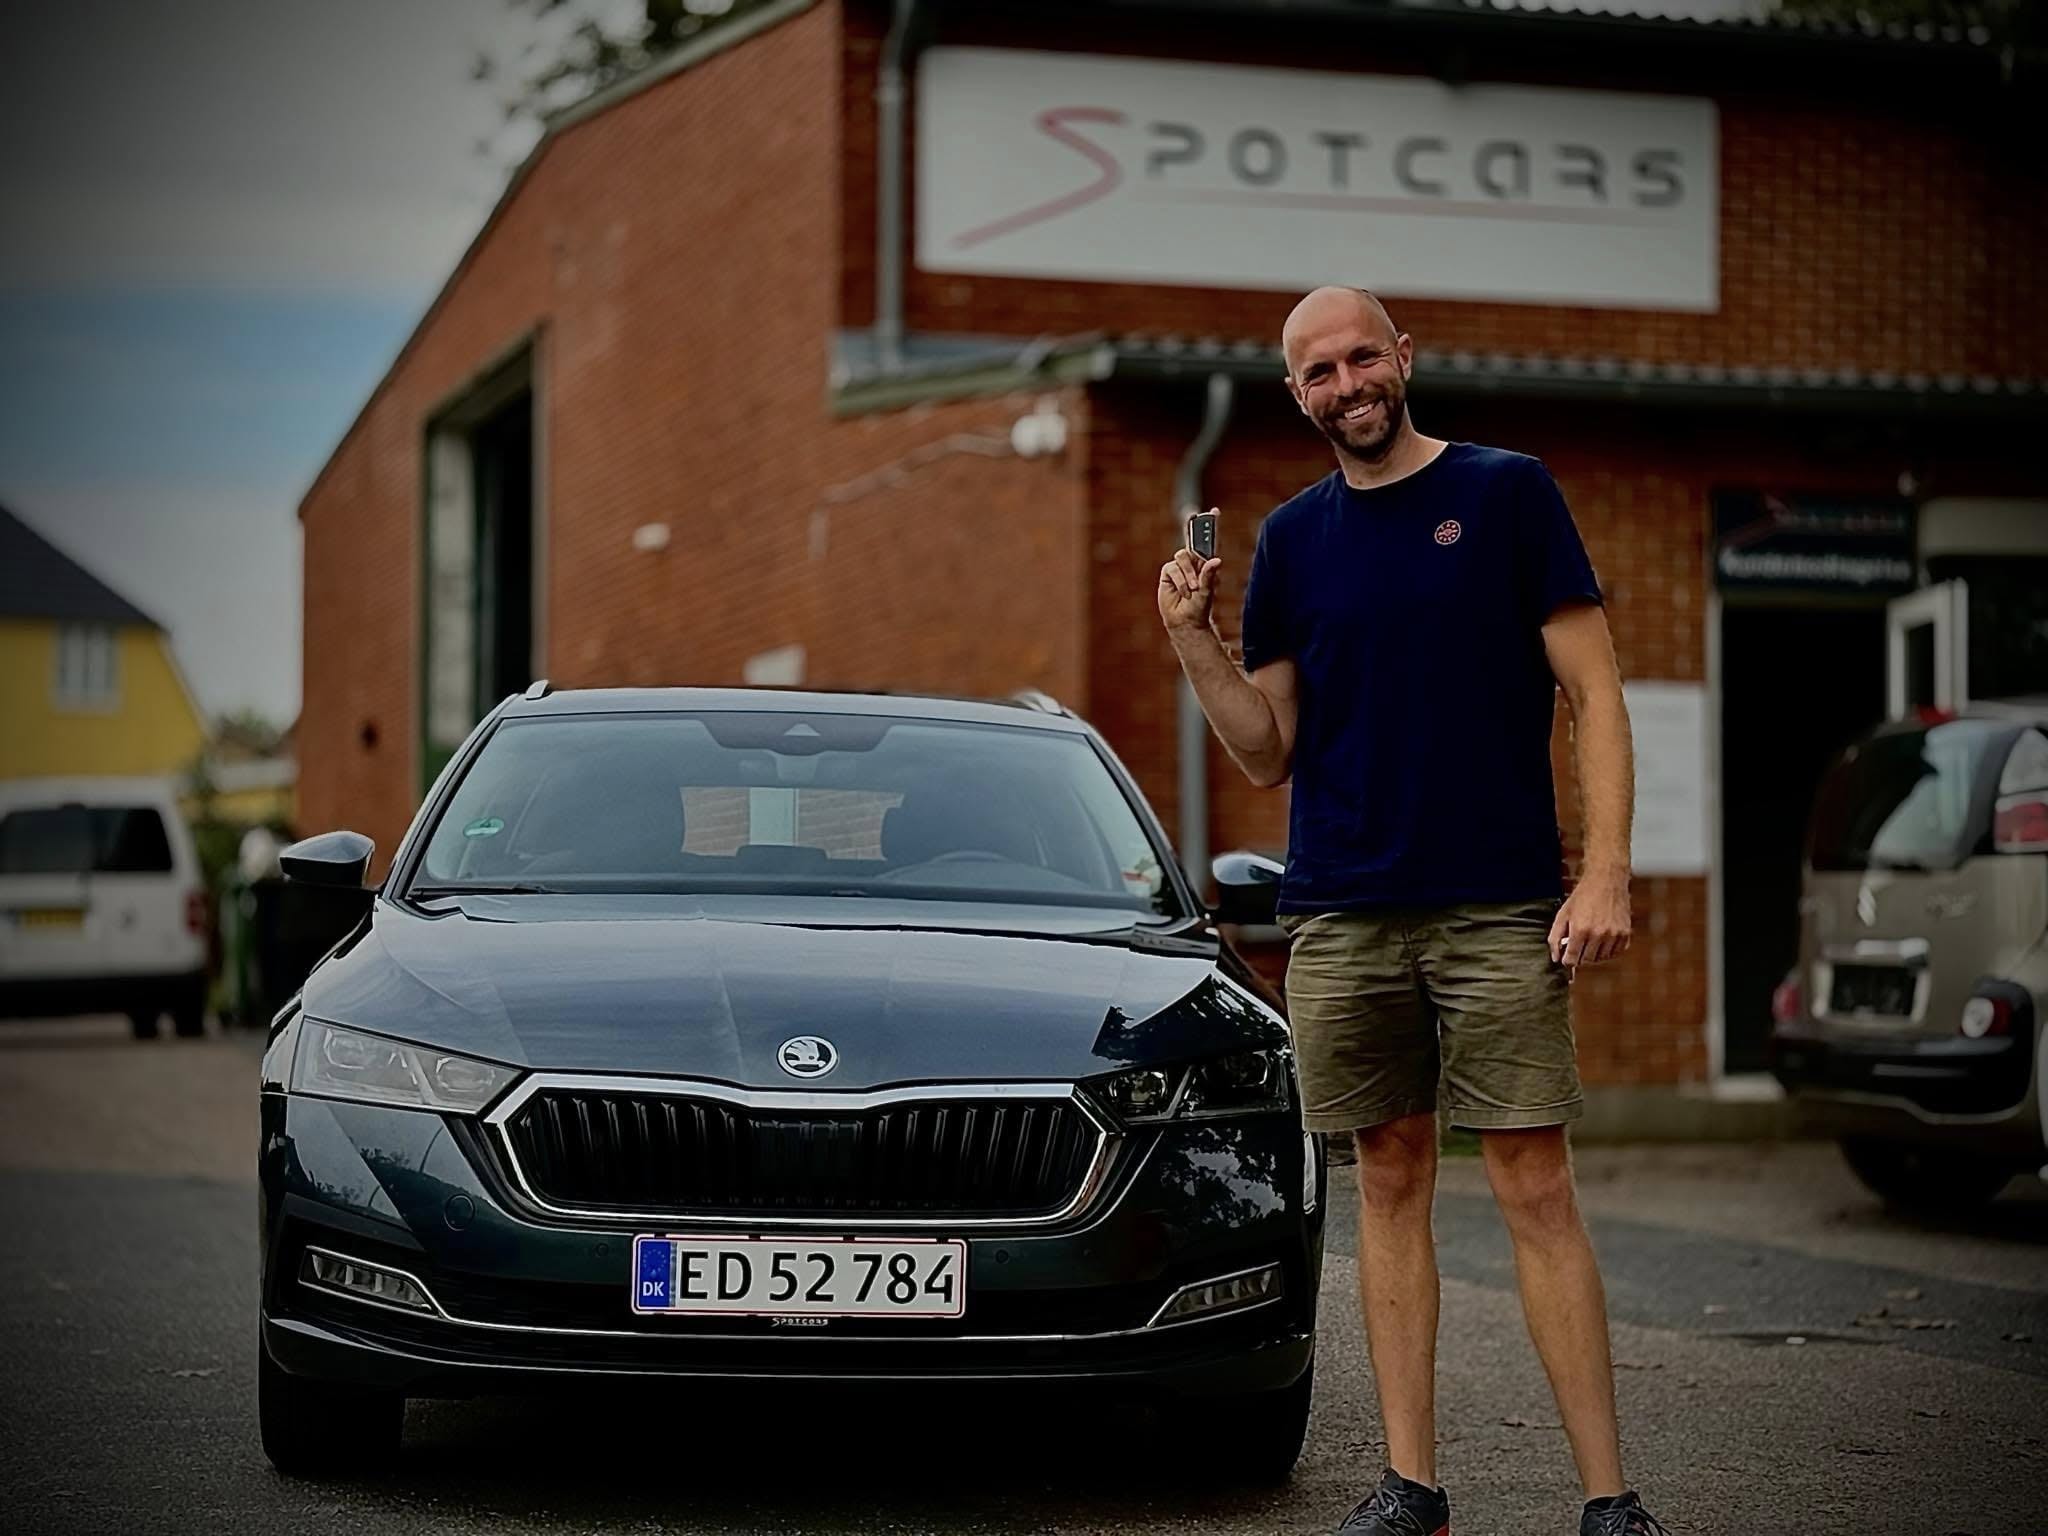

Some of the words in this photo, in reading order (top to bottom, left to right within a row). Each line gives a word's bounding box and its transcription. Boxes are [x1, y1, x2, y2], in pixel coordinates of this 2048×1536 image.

[642, 1282, 665, 1297] DK
[680, 1252, 752, 1301] ED
[768, 1253, 835, 1302] 52
[852, 1254, 954, 1304] 784
